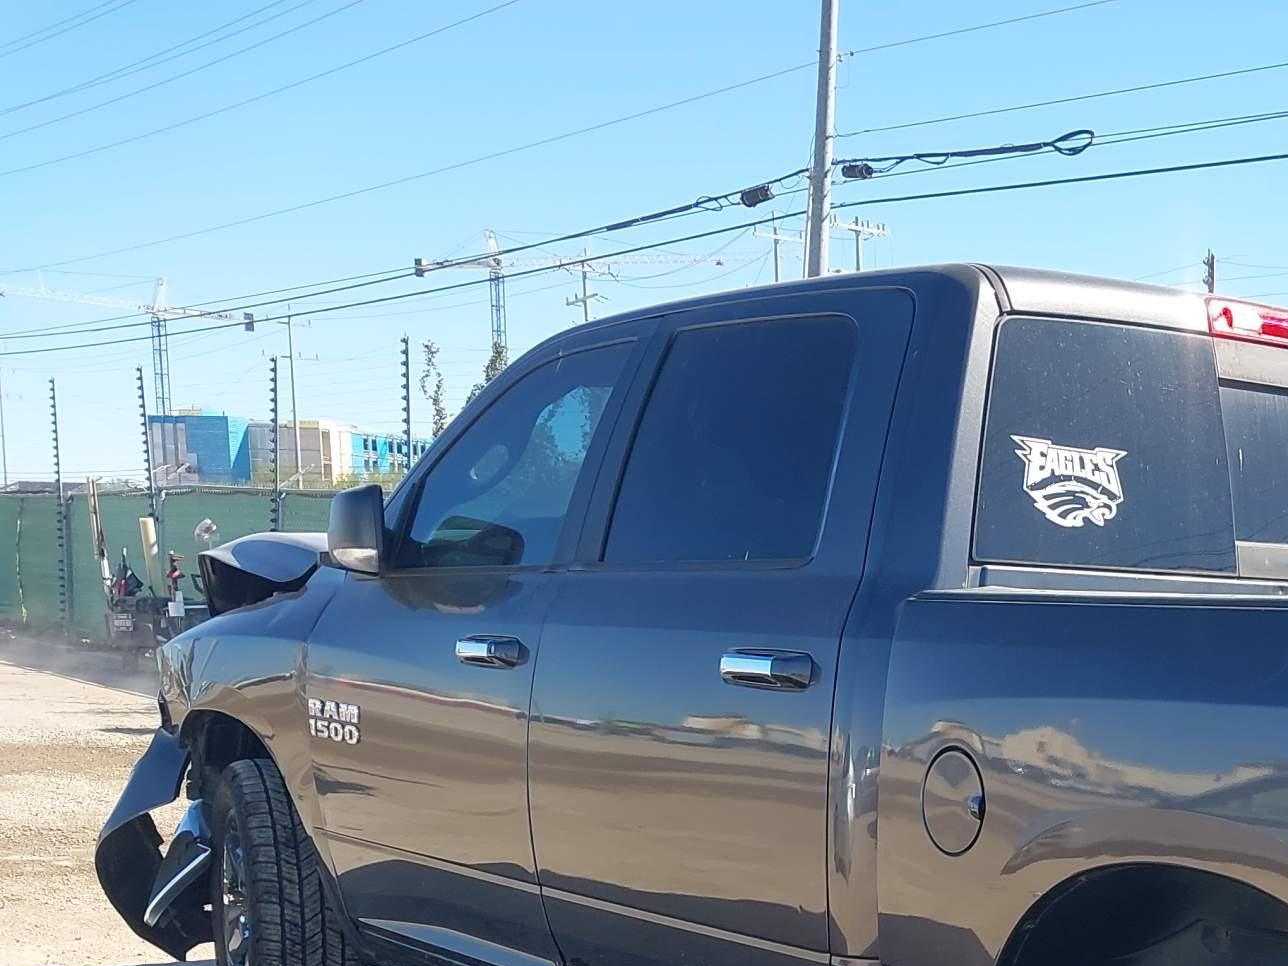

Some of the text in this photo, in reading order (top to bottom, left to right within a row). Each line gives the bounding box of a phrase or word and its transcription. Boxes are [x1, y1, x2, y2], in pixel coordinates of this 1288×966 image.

[1021, 439, 1121, 499] EAGLES
[307, 697, 360, 724] RAM
[308, 718, 361, 745] 1500
